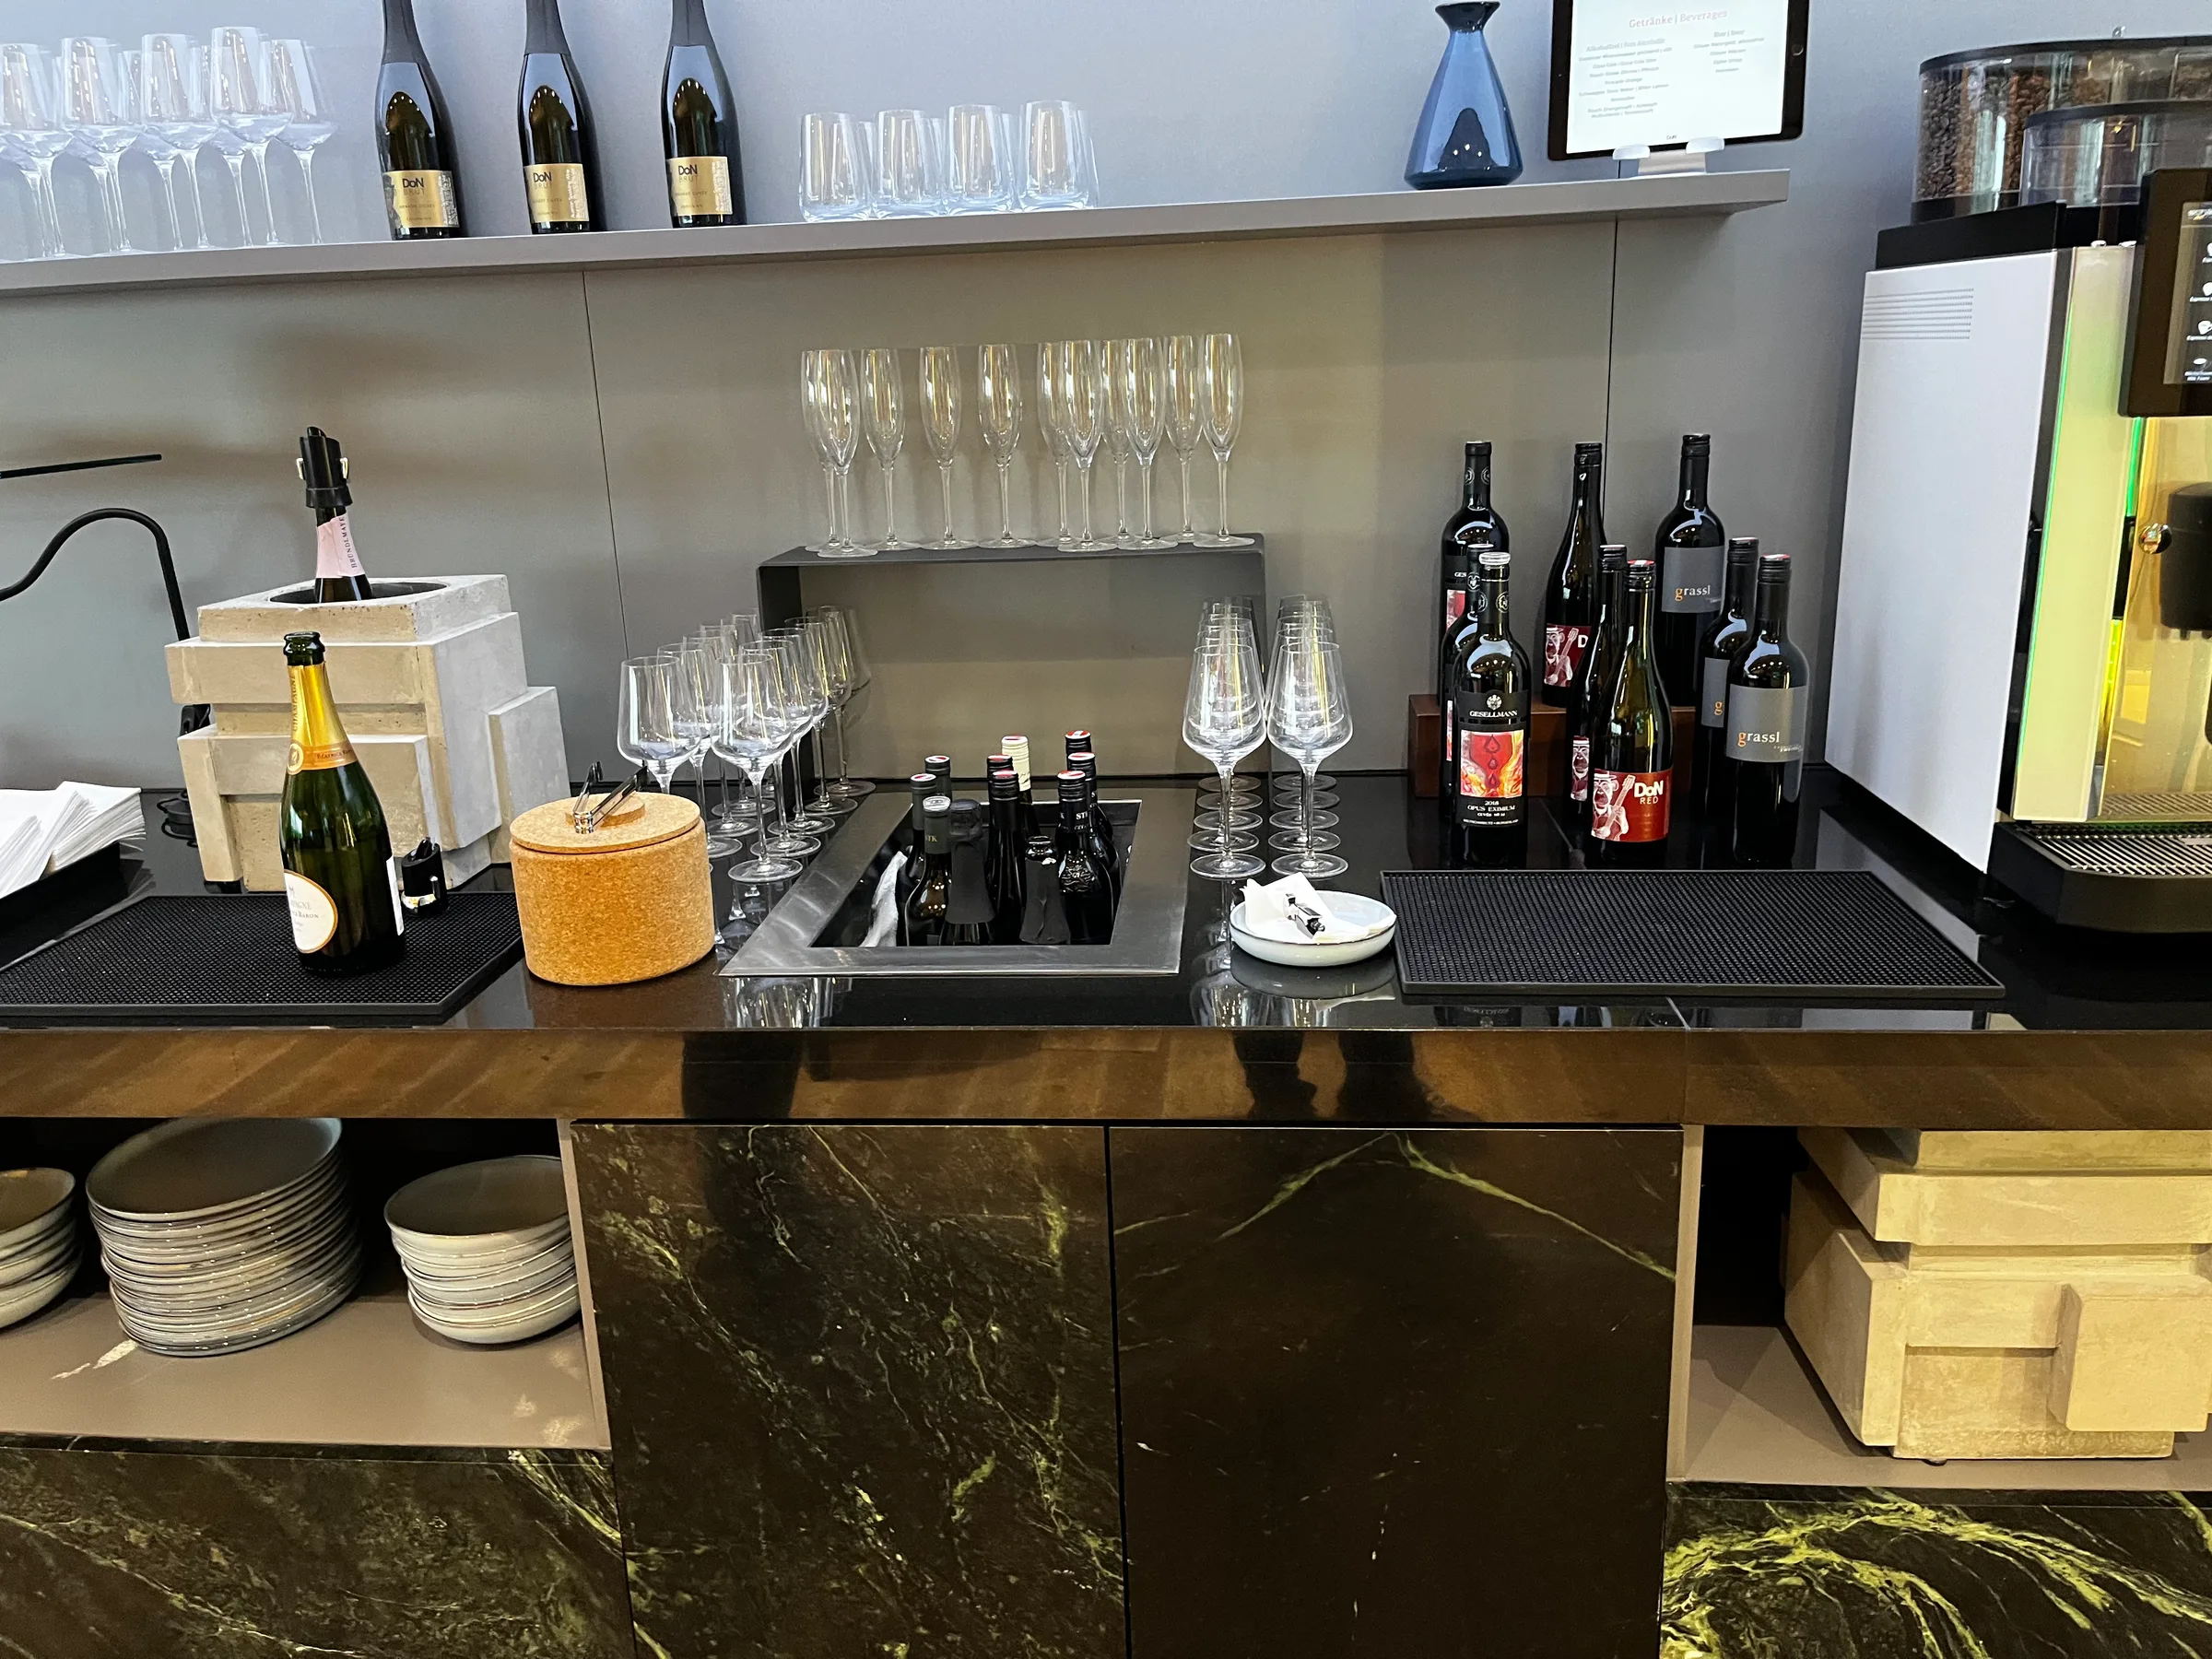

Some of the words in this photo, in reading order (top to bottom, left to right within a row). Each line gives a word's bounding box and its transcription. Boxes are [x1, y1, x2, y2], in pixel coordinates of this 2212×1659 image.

[1629, 16, 1673, 29] Getränke
[1680, 10, 1728, 22] Beverages
[677, 164, 698, 176] DoN
[533, 171, 552, 182] DoN
[402, 177, 425, 189] DoN
[1675, 584, 1711, 602] grassl
[1469, 710, 1518, 718] GESELLMANN
[1737, 731, 1780, 747] grassl
[1634, 780, 1664, 798] DoN
[1640, 795, 1659, 805] RED
